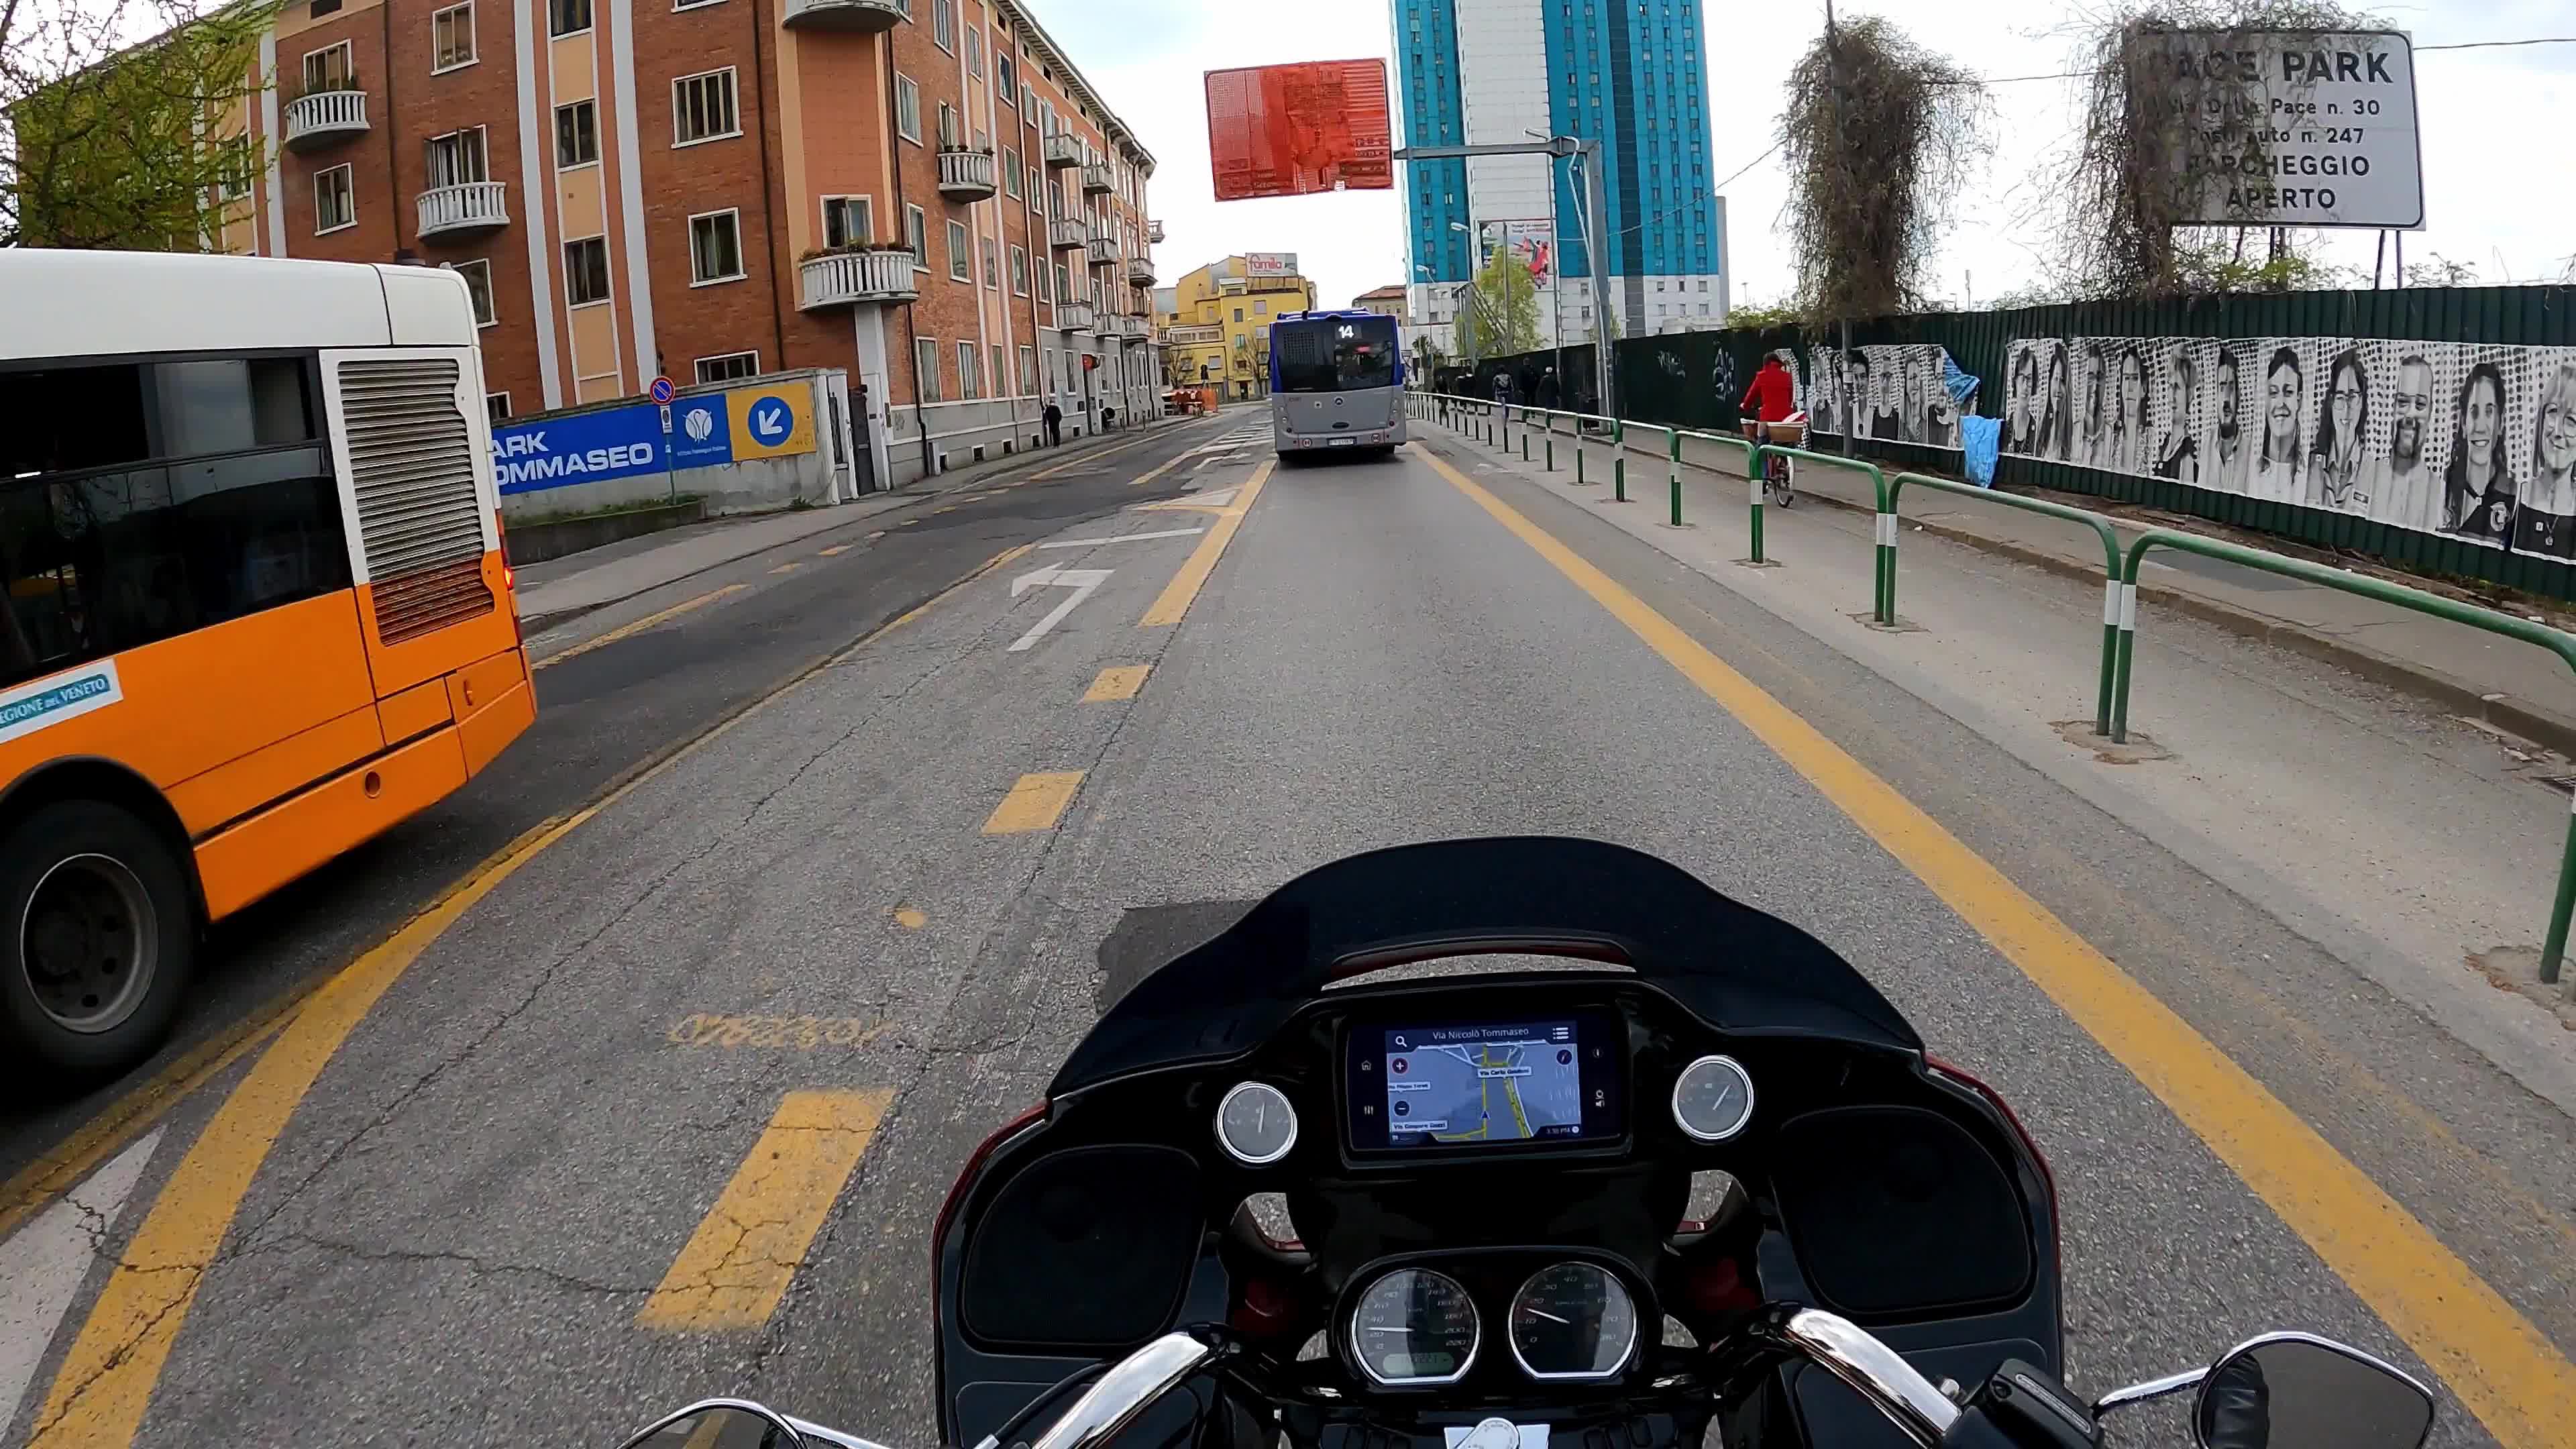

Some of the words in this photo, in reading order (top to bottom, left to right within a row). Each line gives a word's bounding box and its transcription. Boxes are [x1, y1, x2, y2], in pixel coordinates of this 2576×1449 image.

[2151, 50, 2260, 81] ACE
[2283, 52, 2394, 84] PARK
[2271, 98, 2316, 115] Pace
[2327, 103, 2343, 115] n.
[2353, 99, 2381, 115] 30
[2246, 127, 2291, 143] uto
[2301, 131, 2318, 143] n.
[2326, 127, 2364, 144] 247
[2225, 188, 2336, 209] APERTO
[1338, 325, 1354, 339] 14
[60, 678, 105, 702] VENETO
[1433, 1031, 1446, 1040] Via
[1481, 1028, 1529, 1037] Tommaseo
